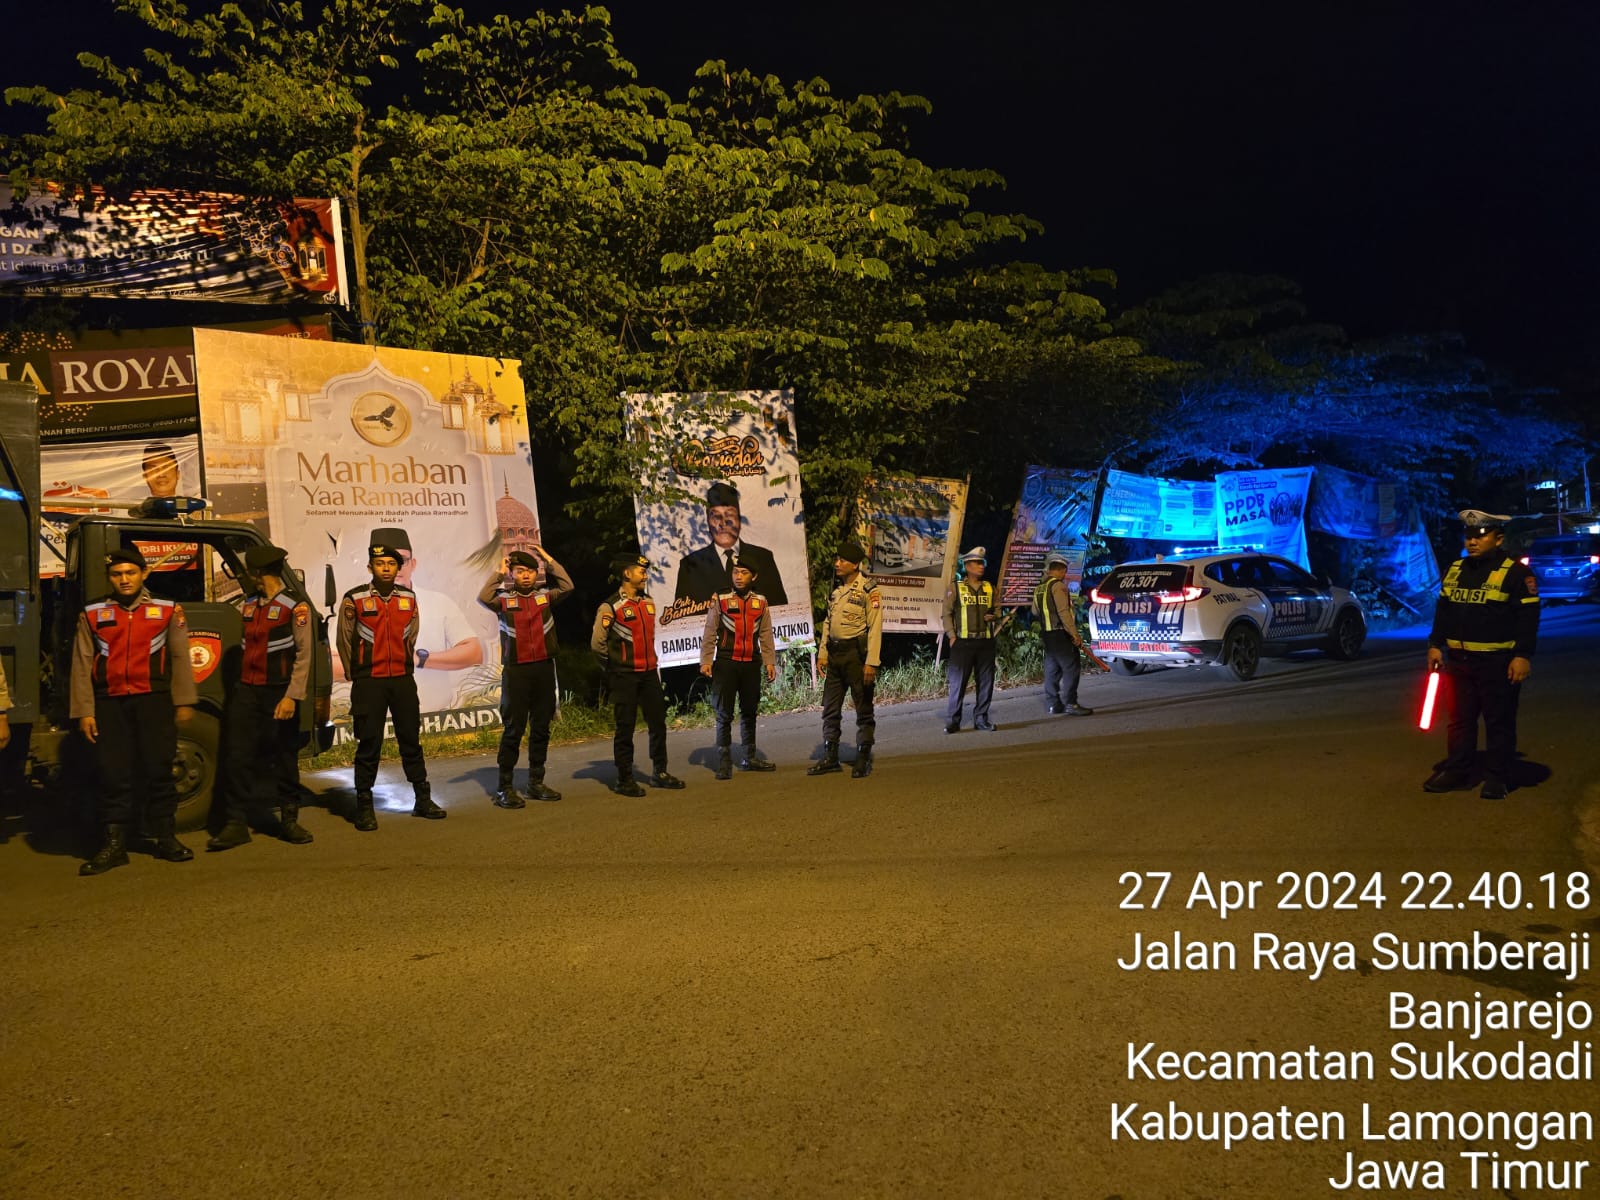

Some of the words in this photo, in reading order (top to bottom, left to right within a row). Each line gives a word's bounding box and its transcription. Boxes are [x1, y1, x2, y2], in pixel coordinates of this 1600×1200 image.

[297, 452, 467, 485] Marhaban
[300, 485, 344, 507] Yaa
[353, 485, 466, 507] Ramadhan
[1224, 493, 1265, 516] PPDB
[1225, 510, 1266, 527] MASA
[1120, 576, 1159, 589] 60.301
[1450, 589, 1486, 602] POLISI
[674, 597, 692, 610] Cak
[1114, 602, 1152, 614] POLISI
[1275, 601, 1306, 616] POLISI
[1138, 642, 1171, 653] PATROL
